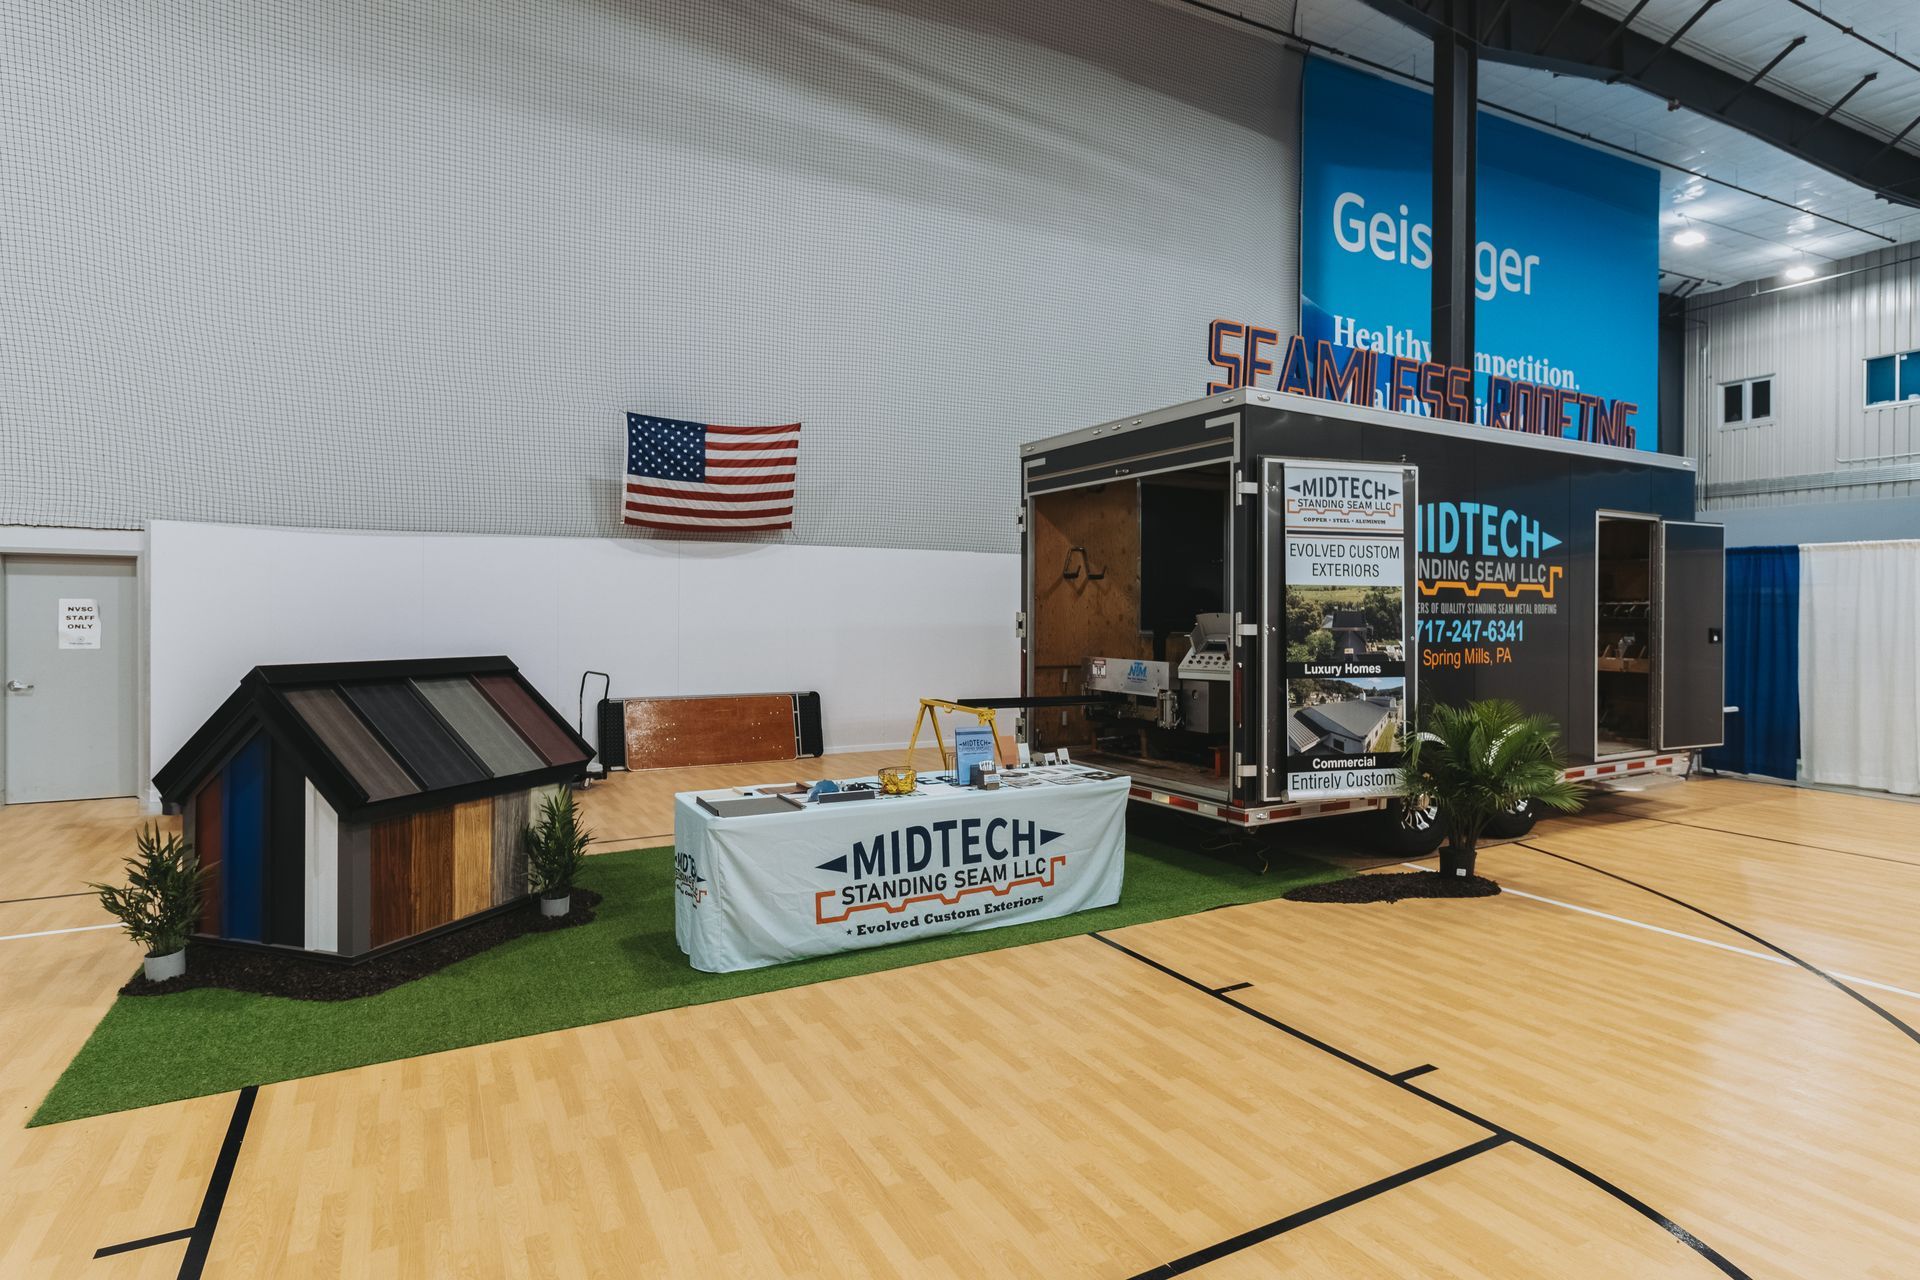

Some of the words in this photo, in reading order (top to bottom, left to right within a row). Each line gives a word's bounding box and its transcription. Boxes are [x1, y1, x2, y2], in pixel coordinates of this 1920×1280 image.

[1333, 192, 1539, 300] Geisger
[1475, 352, 1580, 390] mpetition.
[1207, 319, 1471, 423] SEAMLESS
[1487, 376, 1638, 449] ROOFING
[1302, 477, 1386, 500] MIDTECH
[1298, 499, 1344, 508] STANDING
[1347, 500, 1372, 509] SEAM
[1375, 502, 1392, 510] LLC
[1290, 543, 1345, 557] EVOLVED
[1349, 545, 1399, 558] CUSTOM
[1312, 563, 1380, 577] EXTERIORS
[1419, 559, 1469, 580] NDING
[1475, 562, 1515, 582] SEAM
[1521, 564, 1546, 583] LLC
[1431, 603, 1439, 613] OF
[1441, 603, 1466, 614] QUALITY
[1467, 603, 1496, 614] STANDING
[1498, 603, 1513, 614] SEAM
[1515, 603, 1532, 614] METAL
[1534, 604, 1557, 614] ROOFING
[1418, 620, 1523, 643] 717-247-6341
[1304, 664, 1342, 676] Luxury
[1345, 663, 1381, 674] Homes
[1423, 649, 1461, 669] Spring
[1465, 648, 1492, 666] Mills,
[1496, 648, 1512, 663] PA
[1312, 756, 1376, 769] Commercial
[1292, 774, 1341, 790] Entirely
[1346, 772, 1396, 786] Custom
[853, 818, 1036, 880] MIDTECH
[842, 873, 947, 905] STANDING
[954, 864, 1007, 888] SEAM
[1014, 858, 1046, 878] LLC
[857, 916, 919, 936] Evolved
[924, 908, 980, 926] Custom
[984, 894, 1044, 913] Exteriors
